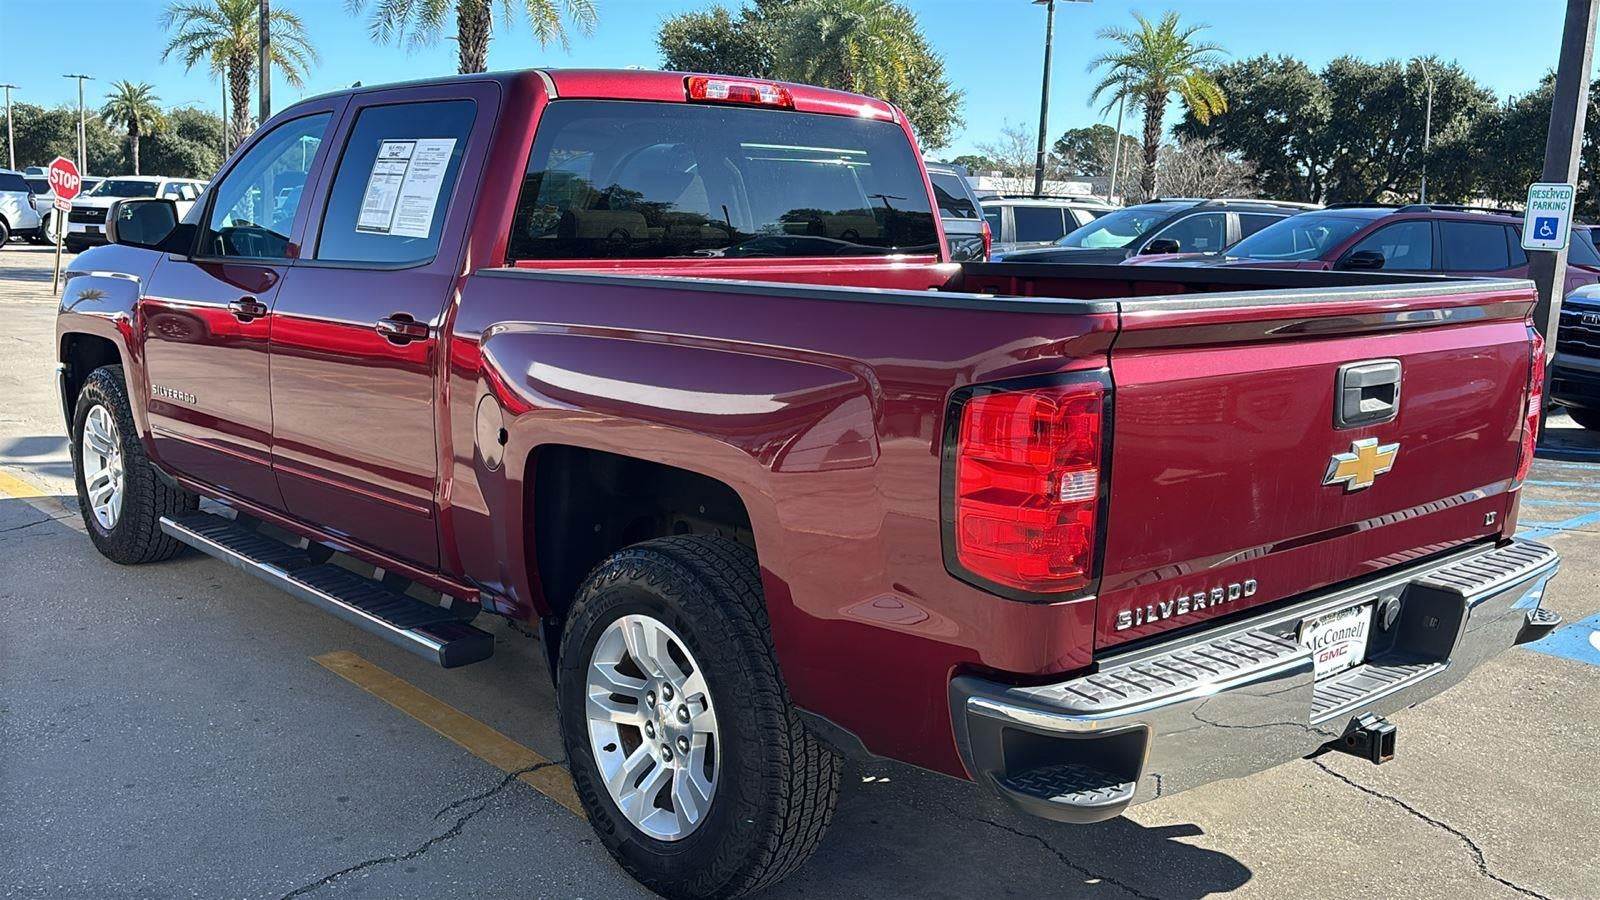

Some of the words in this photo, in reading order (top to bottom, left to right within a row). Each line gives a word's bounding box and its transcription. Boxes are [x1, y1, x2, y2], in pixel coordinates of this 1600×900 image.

[51, 167, 78, 190] STOP
[1532, 190, 1570, 199] RESERVED
[1532, 201, 1567, 210] PARKING
[152, 384, 196, 404] SILVERADO
[1117, 579, 1257, 630] SILVERADO
[1319, 645, 1348, 662] GMC
